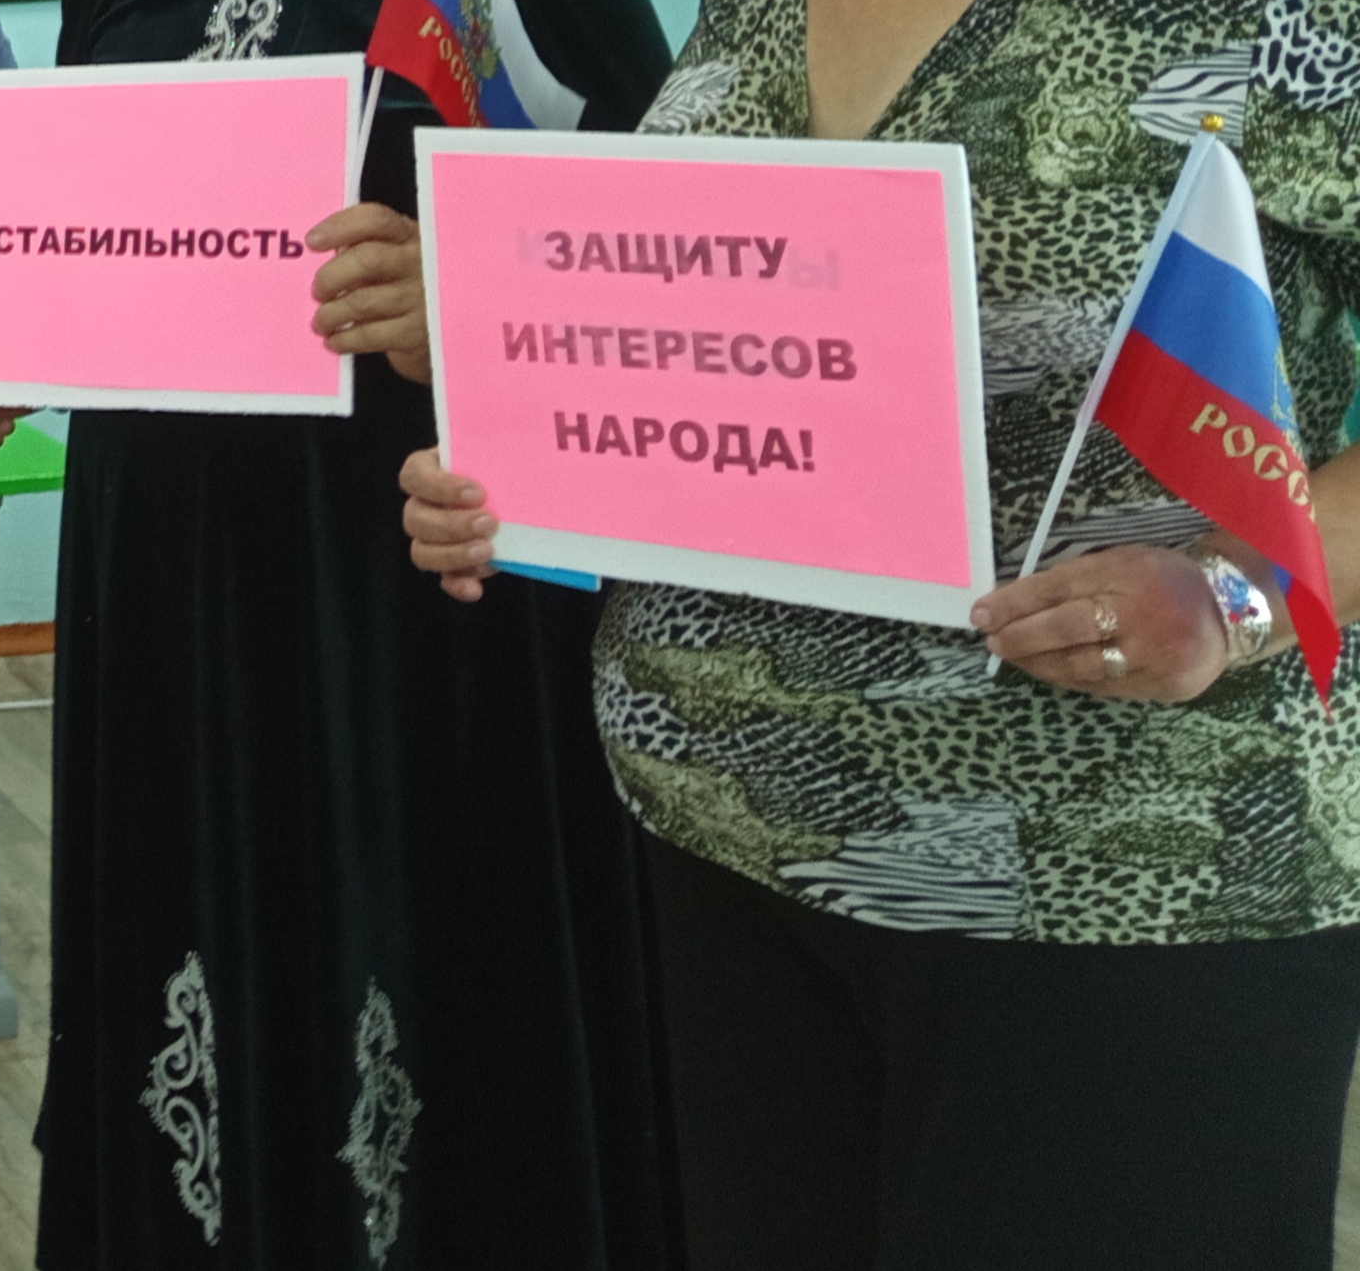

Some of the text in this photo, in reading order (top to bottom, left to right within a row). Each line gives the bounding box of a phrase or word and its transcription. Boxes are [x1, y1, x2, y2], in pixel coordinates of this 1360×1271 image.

[544, 230, 788, 284] ЗАЩИТУ
[502, 321, 858, 382] ИНТЕРЕСОВ
[554, 410, 815, 477] НАРОДА!
[1189, 402, 1316, 523] РОСС
